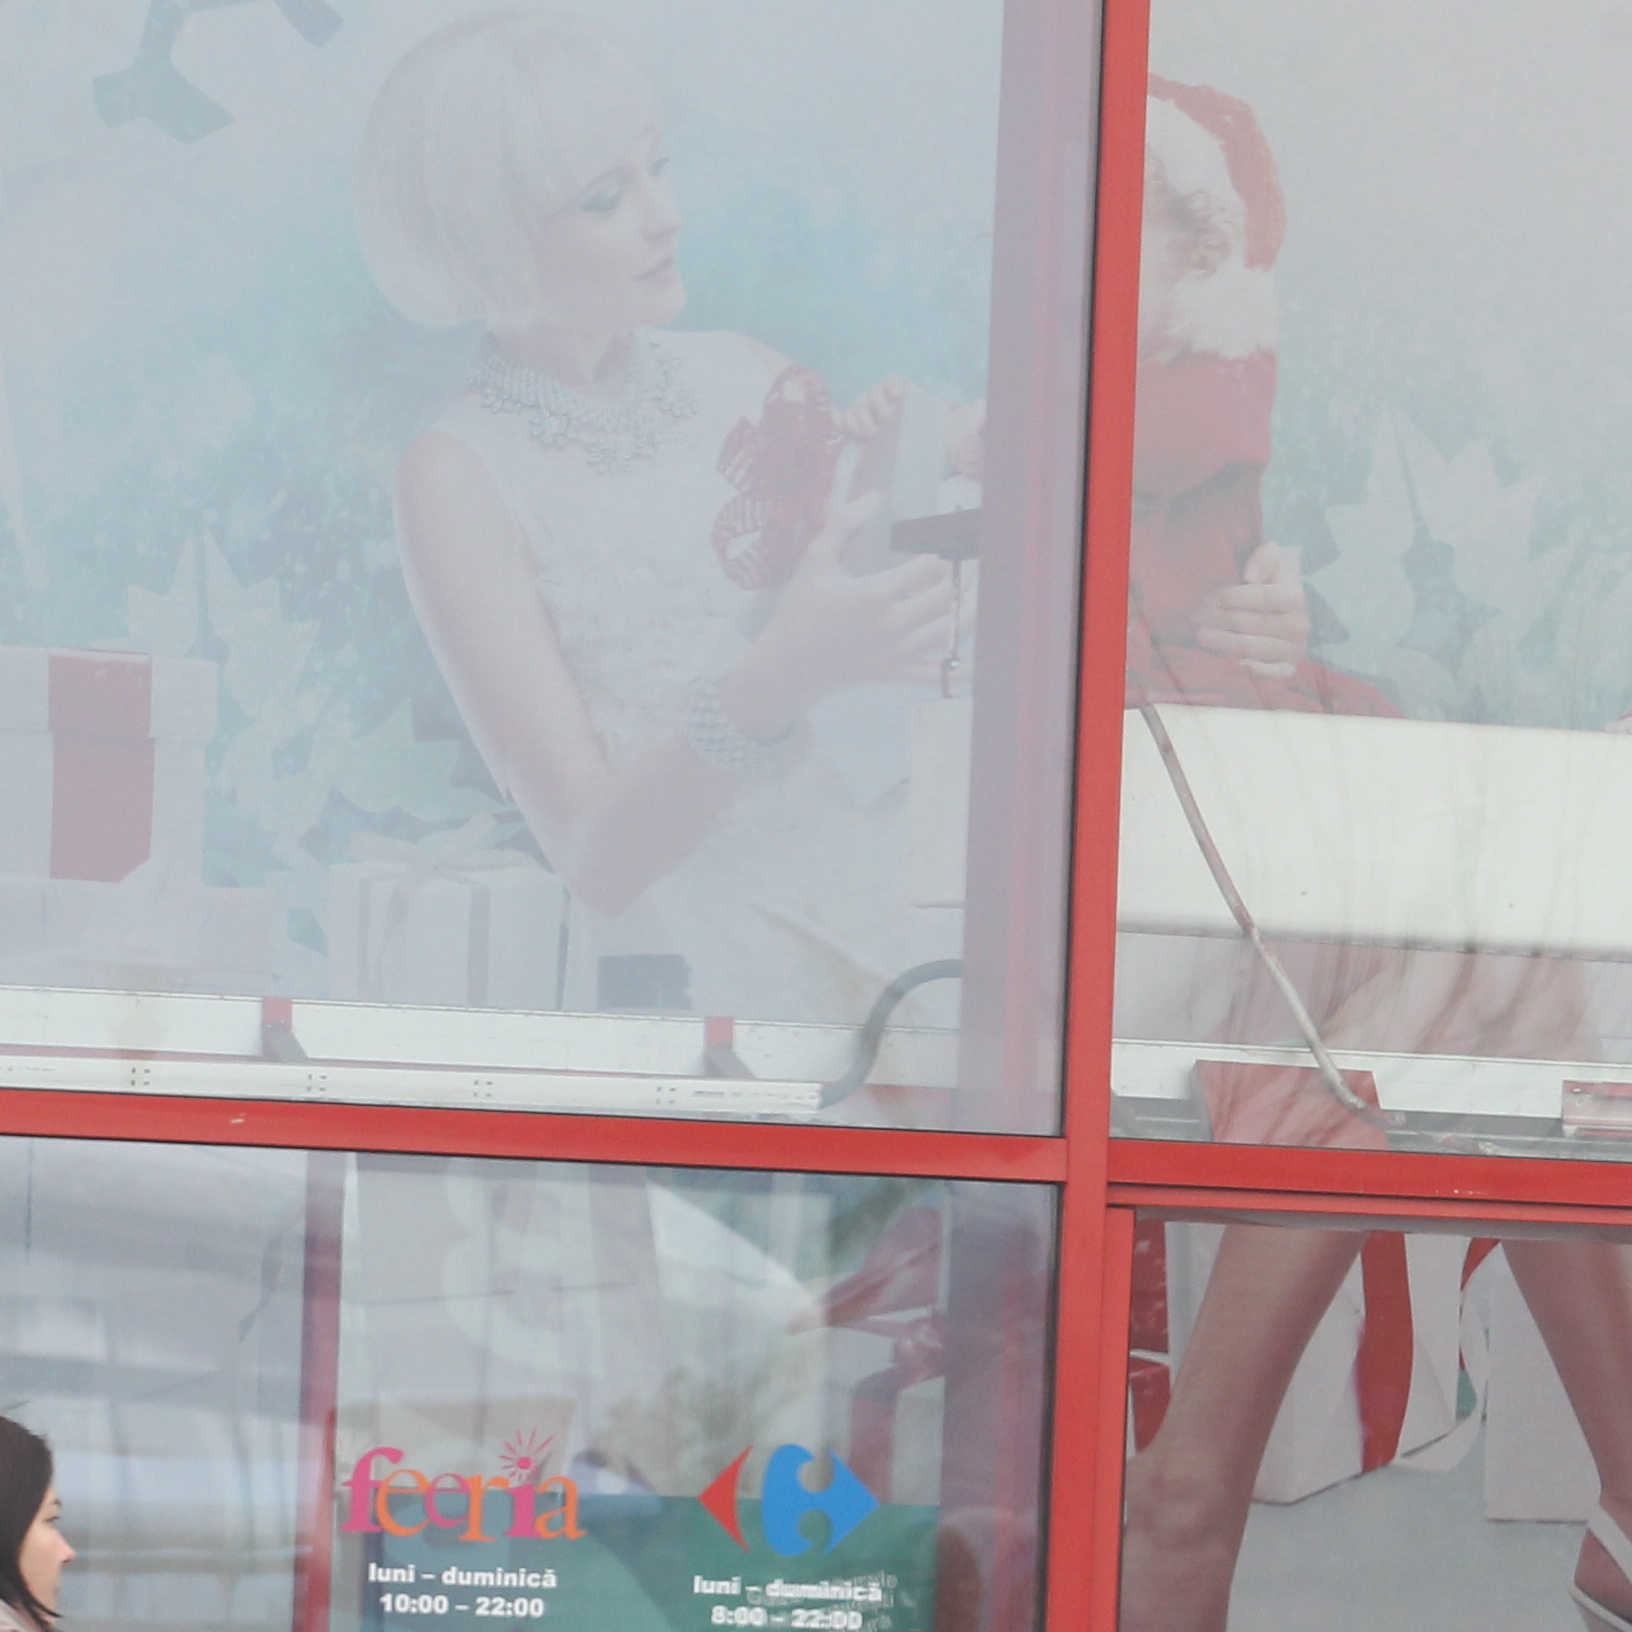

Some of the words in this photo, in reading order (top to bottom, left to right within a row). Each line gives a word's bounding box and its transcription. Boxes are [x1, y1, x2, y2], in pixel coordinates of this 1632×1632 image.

[340, 1446, 588, 1542] feeria
[368, 1563, 416, 1583] luni
[441, 1567, 557, 1588] duminică
[693, 1575, 741, 1595] luni
[379, 1594, 449, 1614] 10:00
[475, 1597, 545, 1617] 22:00
[711, 1605, 768, 1627] 8:00
[791, 1609, 863, 1631] 22:00
